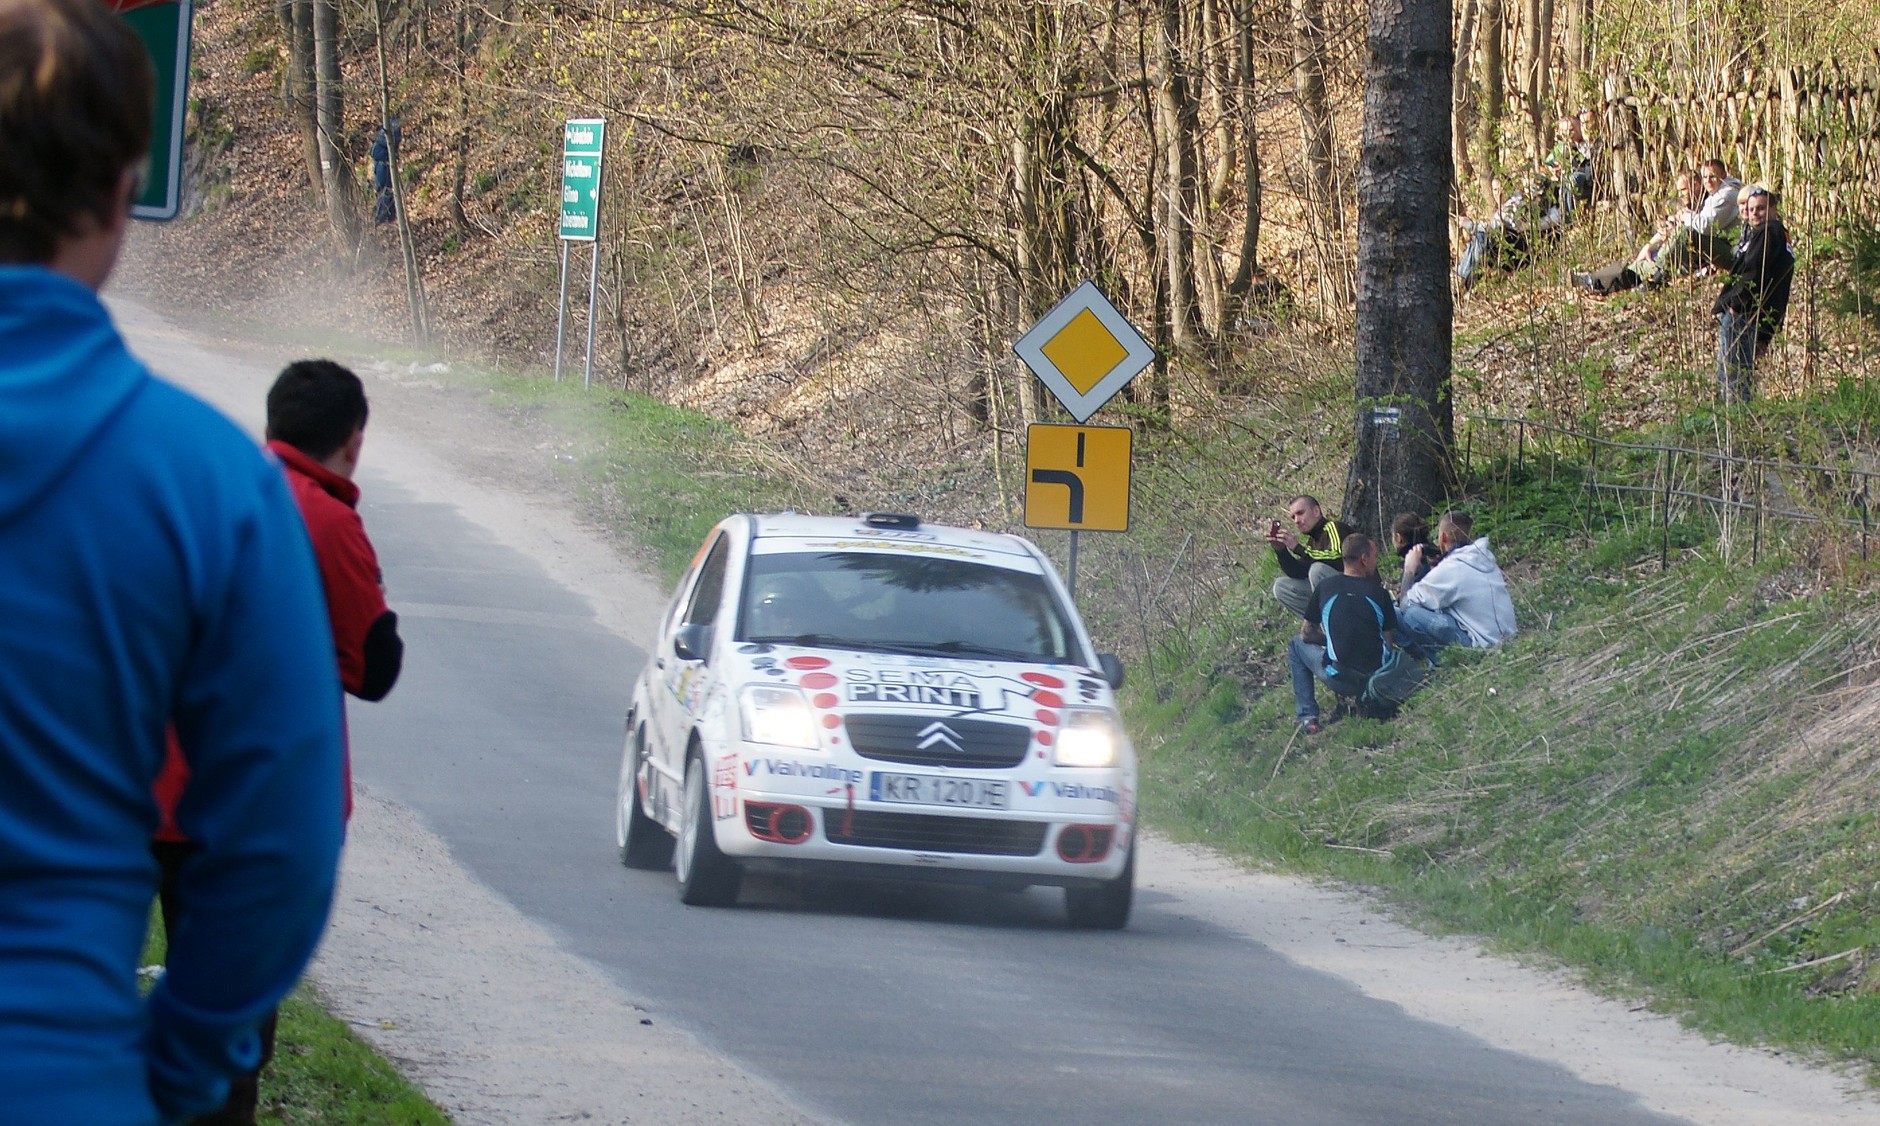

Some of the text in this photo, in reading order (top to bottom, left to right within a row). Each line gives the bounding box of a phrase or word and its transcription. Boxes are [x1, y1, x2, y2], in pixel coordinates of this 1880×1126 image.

[846, 668, 978, 690] SEMA
[849, 684, 980, 708] PRINT
[766, 758, 864, 784] Valvoline
[886, 775, 921, 800] KR
